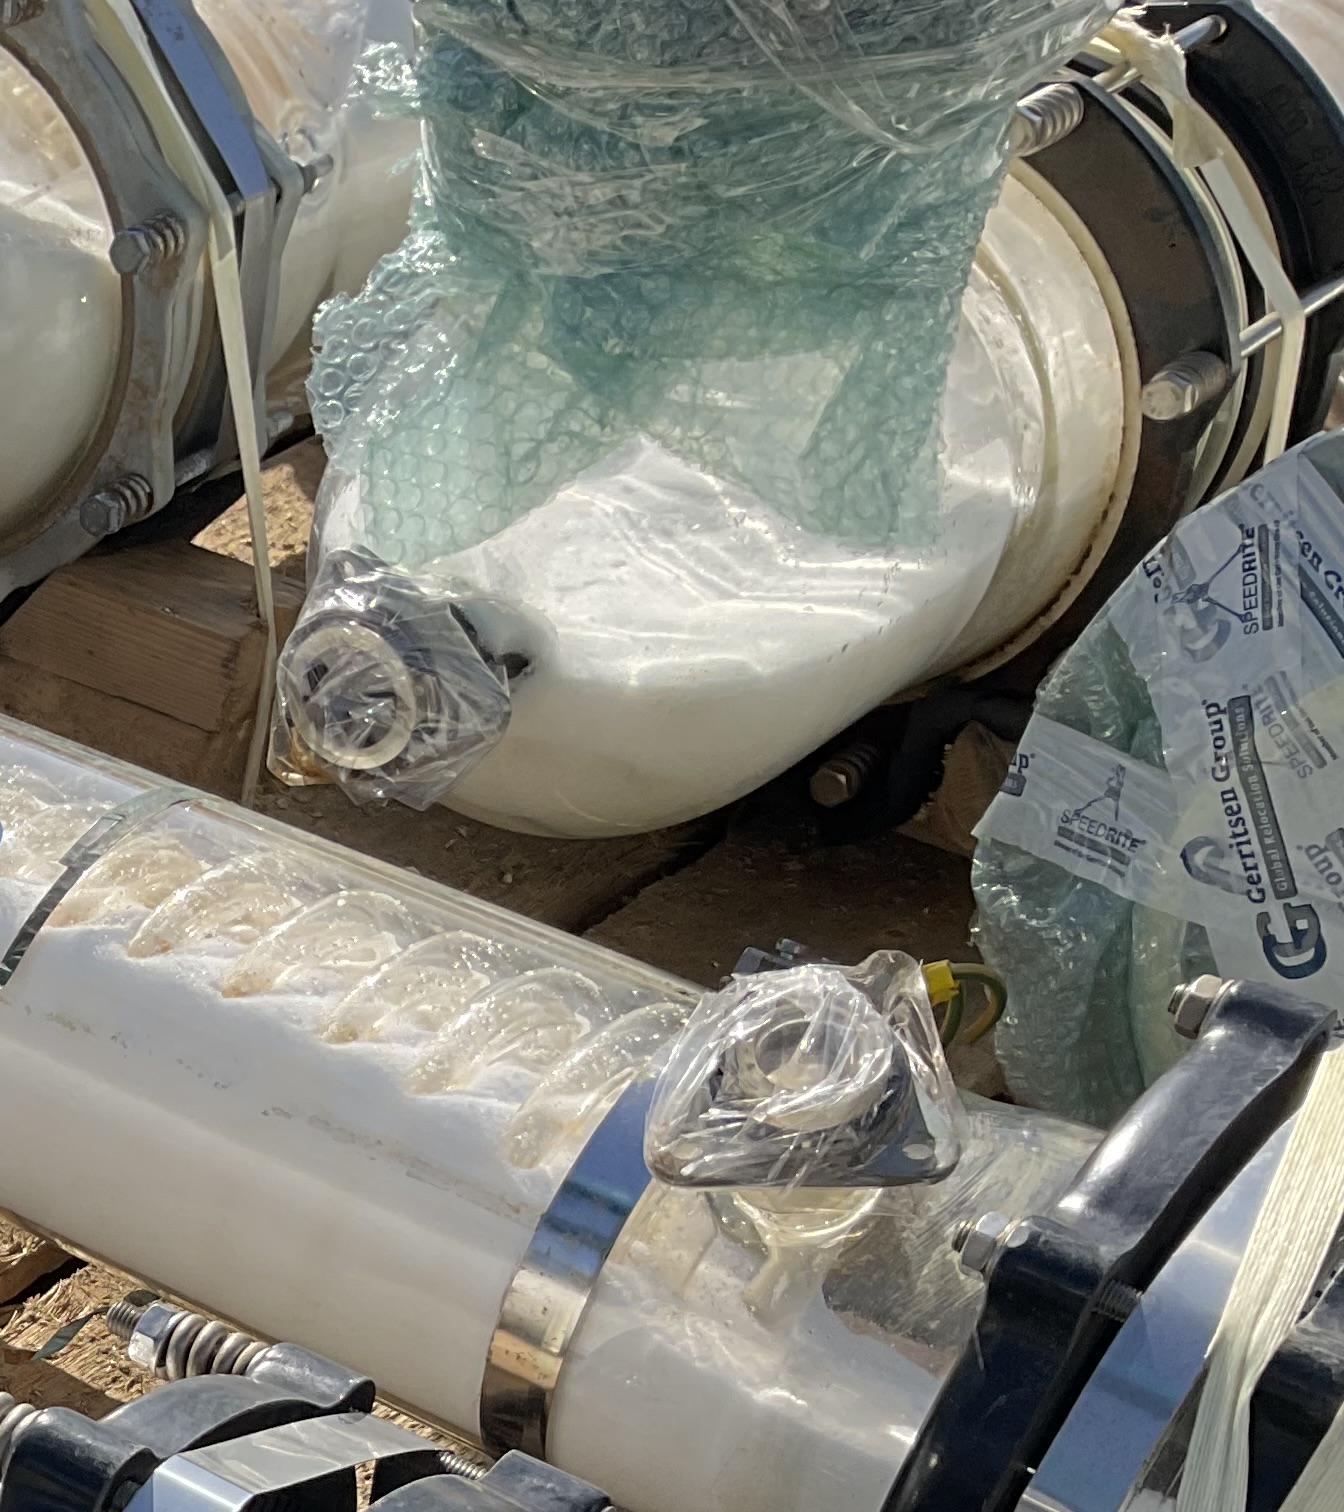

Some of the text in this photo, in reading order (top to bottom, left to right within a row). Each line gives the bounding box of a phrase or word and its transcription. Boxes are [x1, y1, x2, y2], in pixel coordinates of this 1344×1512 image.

[1242, 526, 1259, 635] SPEEDRITE
[1061, 809, 1140, 853] SPEEDRITE
[1205, 702, 1265, 903] Gerritsen Group
[1234, 706, 1288, 892] Global Relocation Solutions
